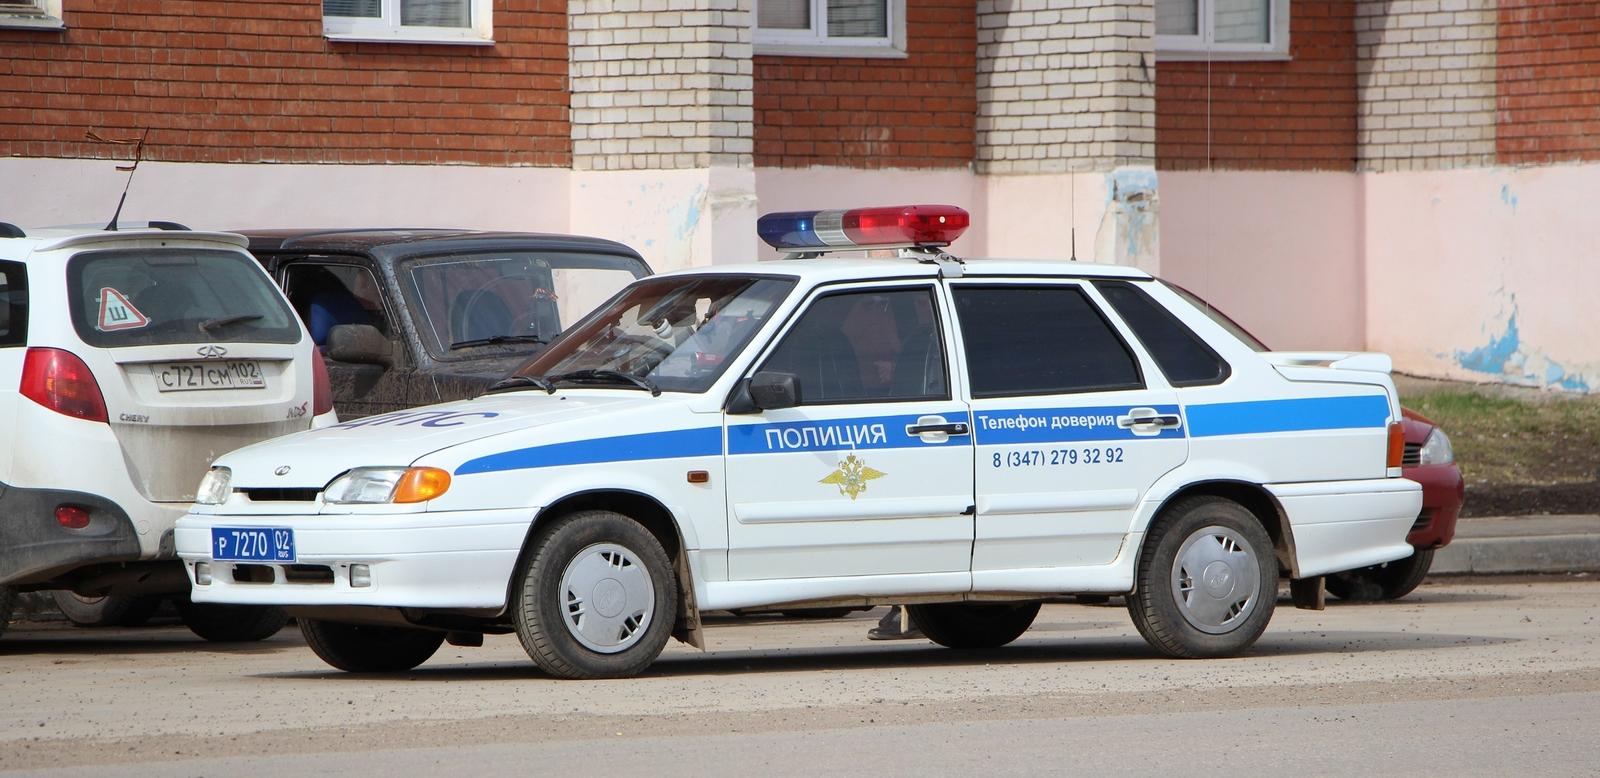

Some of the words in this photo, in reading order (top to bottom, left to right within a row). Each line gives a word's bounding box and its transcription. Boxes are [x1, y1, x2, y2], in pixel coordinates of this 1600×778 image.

[119, 413, 150, 423] CHERY
[978, 414, 1047, 432] Телефон
[1050, 414, 1115, 430] доверия
[765, 423, 887, 450] ПОЛИЦИЯ
[992, 452, 1001, 468] 8
[1007, 450, 1045, 468] (347)
[1050, 449, 1078, 465] 279
[1083, 448, 1101, 464] 32
[1105, 447, 1124, 463] 92
[231, 531, 268, 557] 7270
[274, 530, 290, 550] 02
